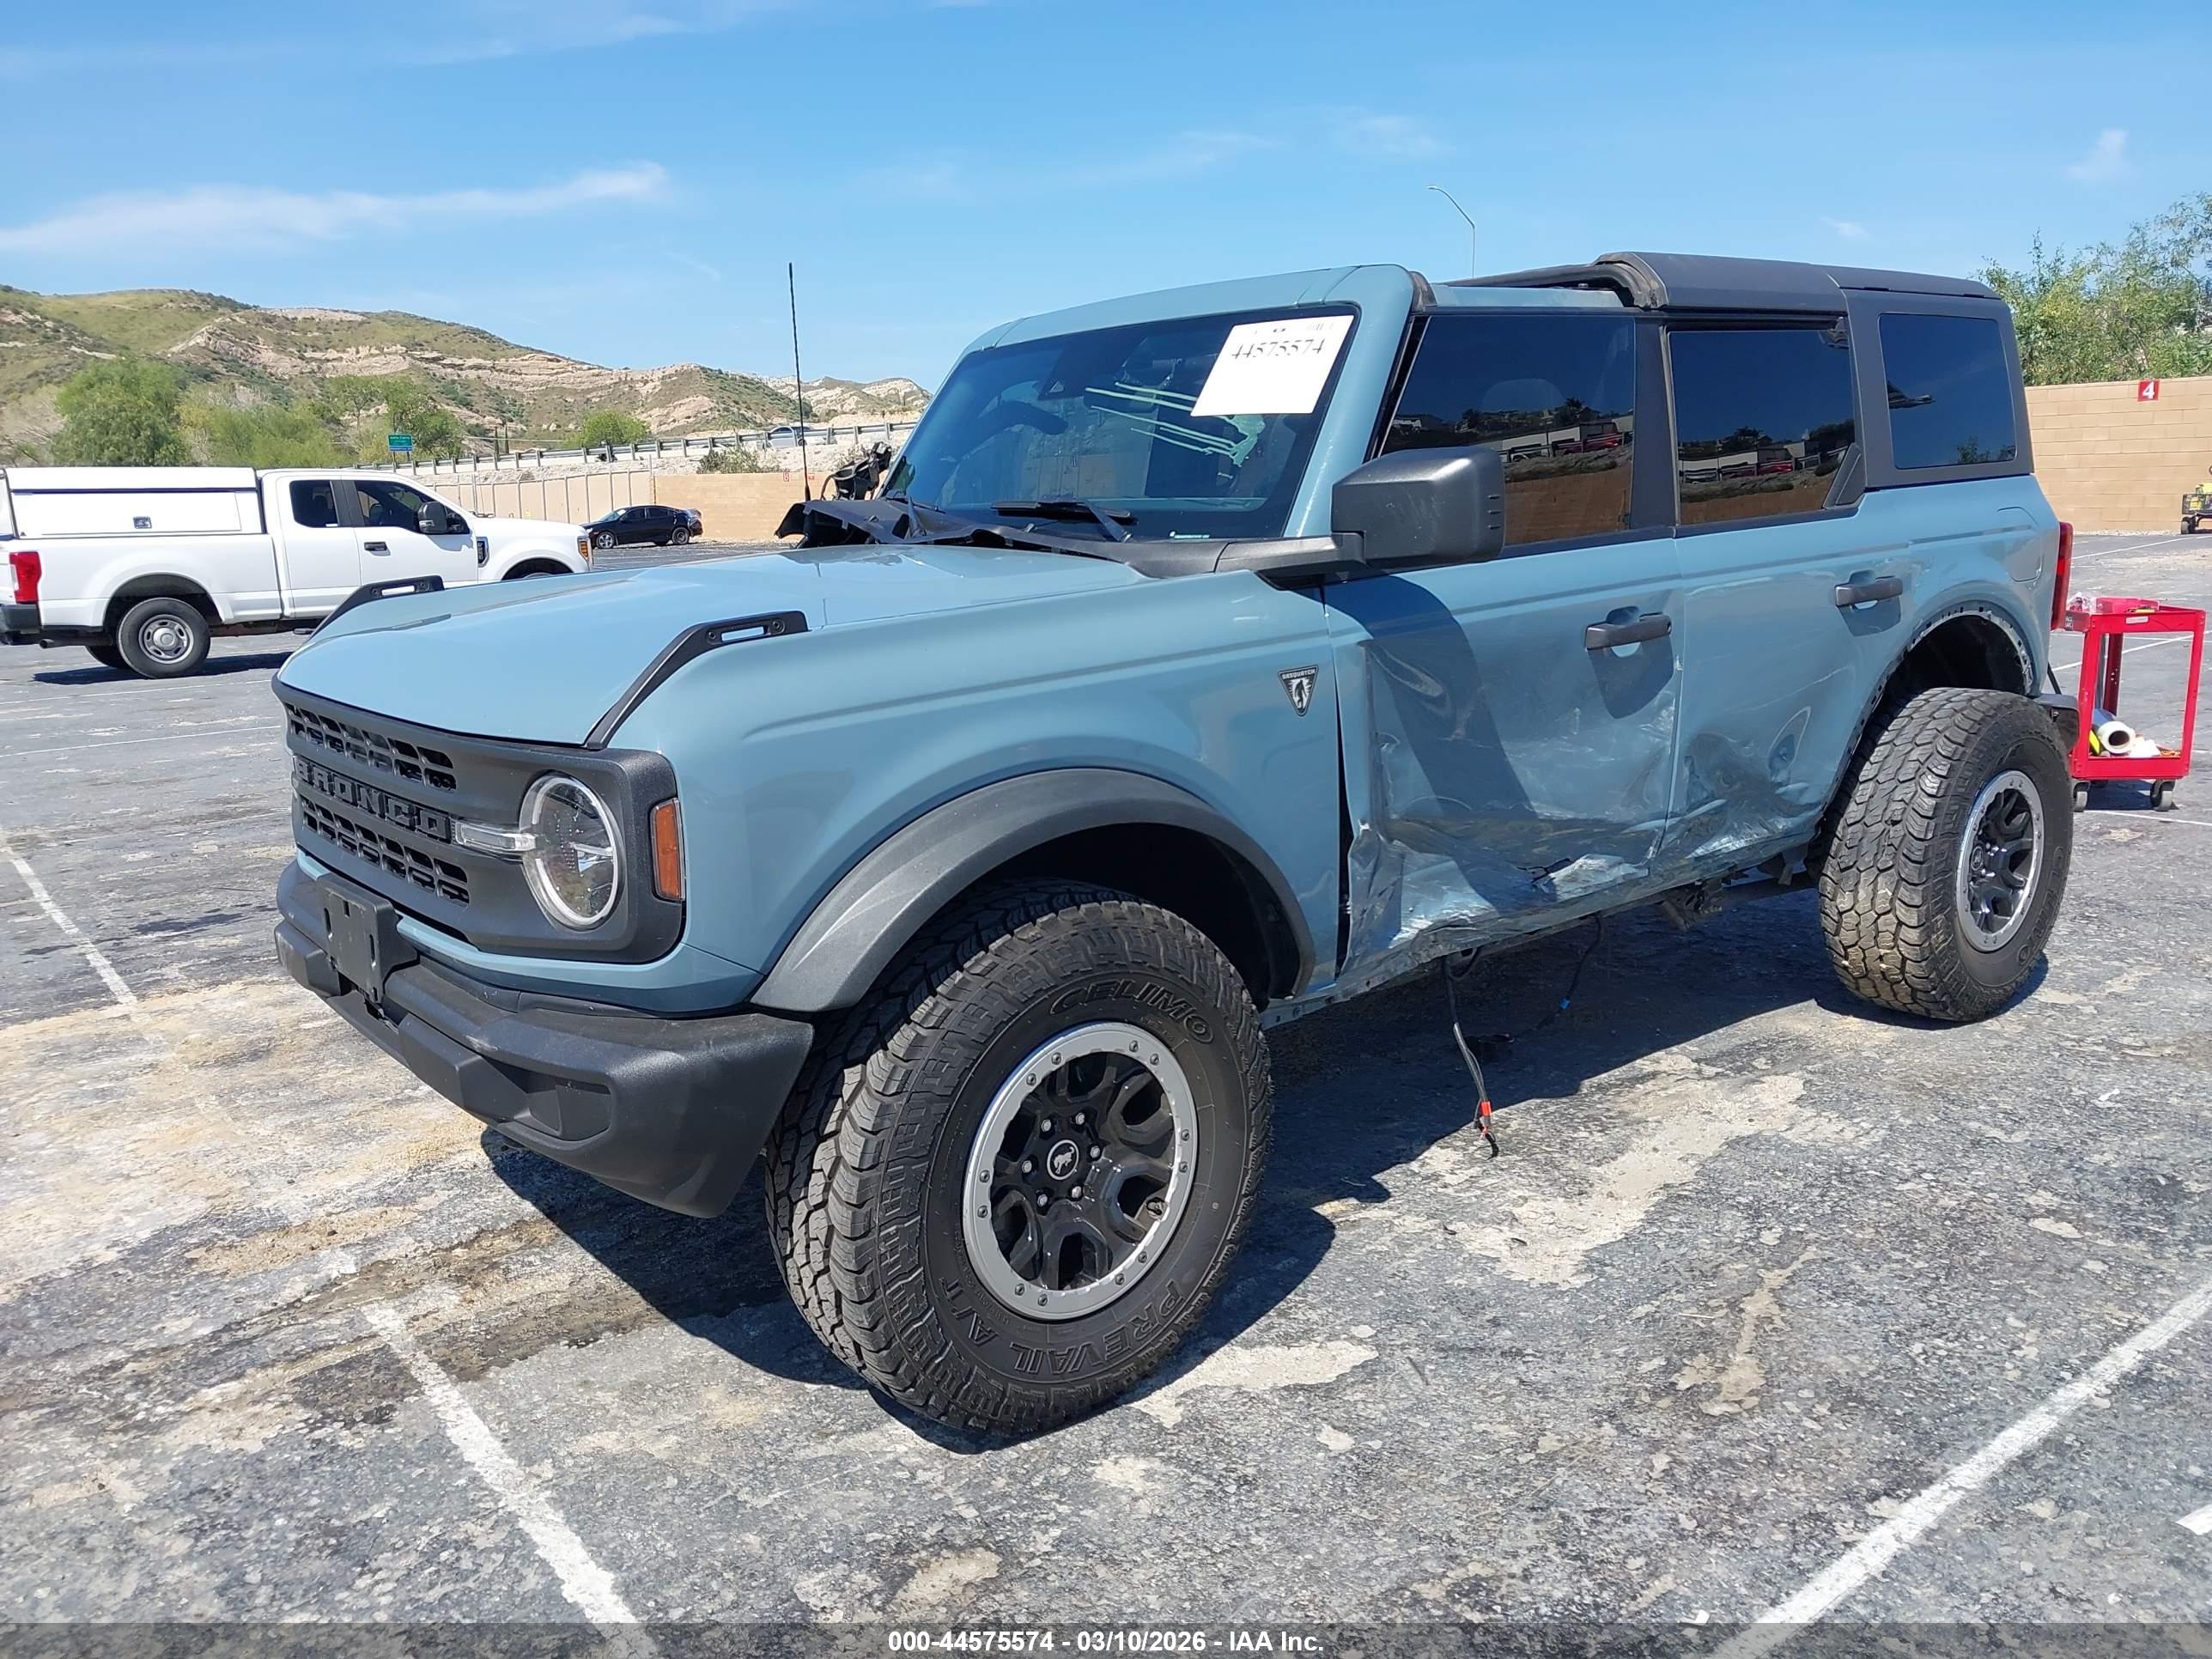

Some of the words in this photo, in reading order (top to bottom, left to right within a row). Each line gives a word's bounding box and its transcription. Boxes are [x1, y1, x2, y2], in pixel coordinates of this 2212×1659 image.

[1231, 338, 1326, 360] 44575574
[2142, 381, 2154, 399] 4
[1282, 669, 1315, 679] SASQUATCH
[294, 756, 451, 845] BRONCO
[1049, 978, 1214, 1044] CELIMO
[1010, 1279, 1187, 1374] PREVAIL
